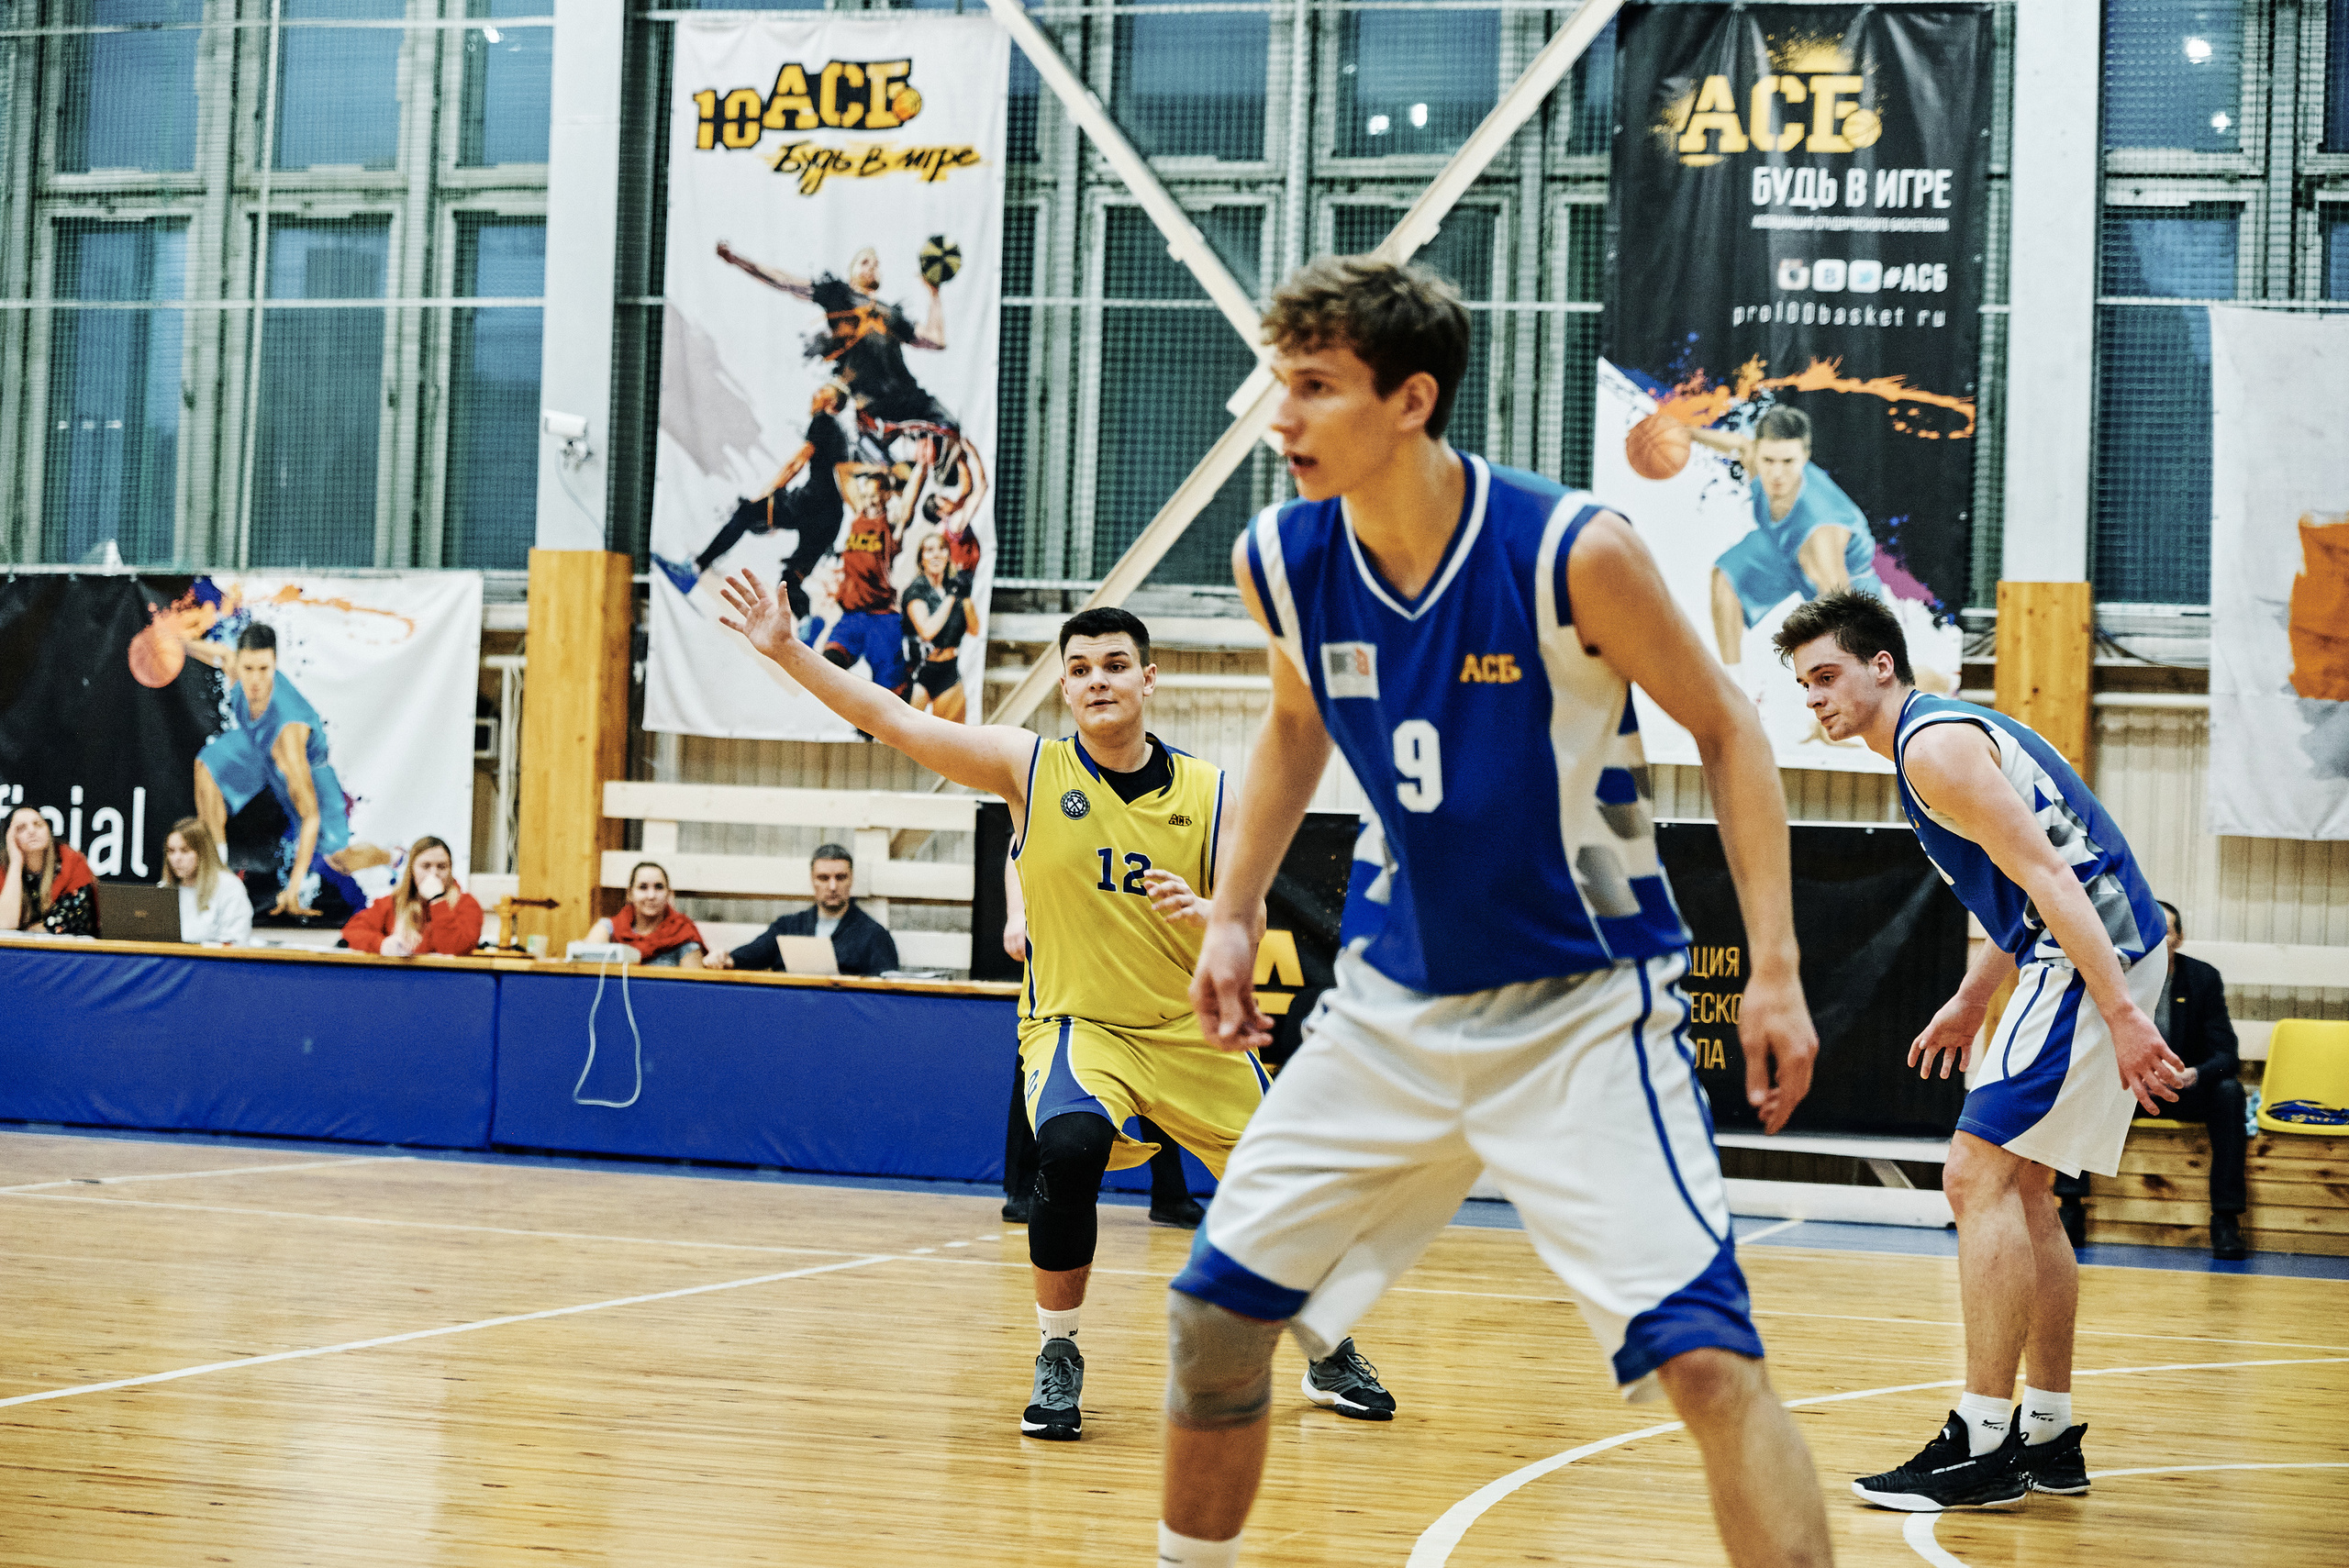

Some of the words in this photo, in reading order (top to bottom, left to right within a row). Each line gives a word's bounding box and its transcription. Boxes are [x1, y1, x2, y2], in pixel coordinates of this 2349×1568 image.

[693, 88, 763, 150] 10
[763, 59, 922, 130] АСБ
[1678, 74, 1883, 153] АСБ
[1752, 166, 1838, 210] БУДЬ
[1845, 167, 1867, 207] В
[1875, 168, 1954, 209] ИГРЕ
[1882, 262, 1948, 293] #АСБ
[1459, 652, 1523, 684] АСБ
[1392, 718, 1443, 813] 9
[1168, 814, 1193, 827] АСБ
[1097, 847, 1152, 897] 12
[1688, 946, 1741, 979] ЦИЯ
